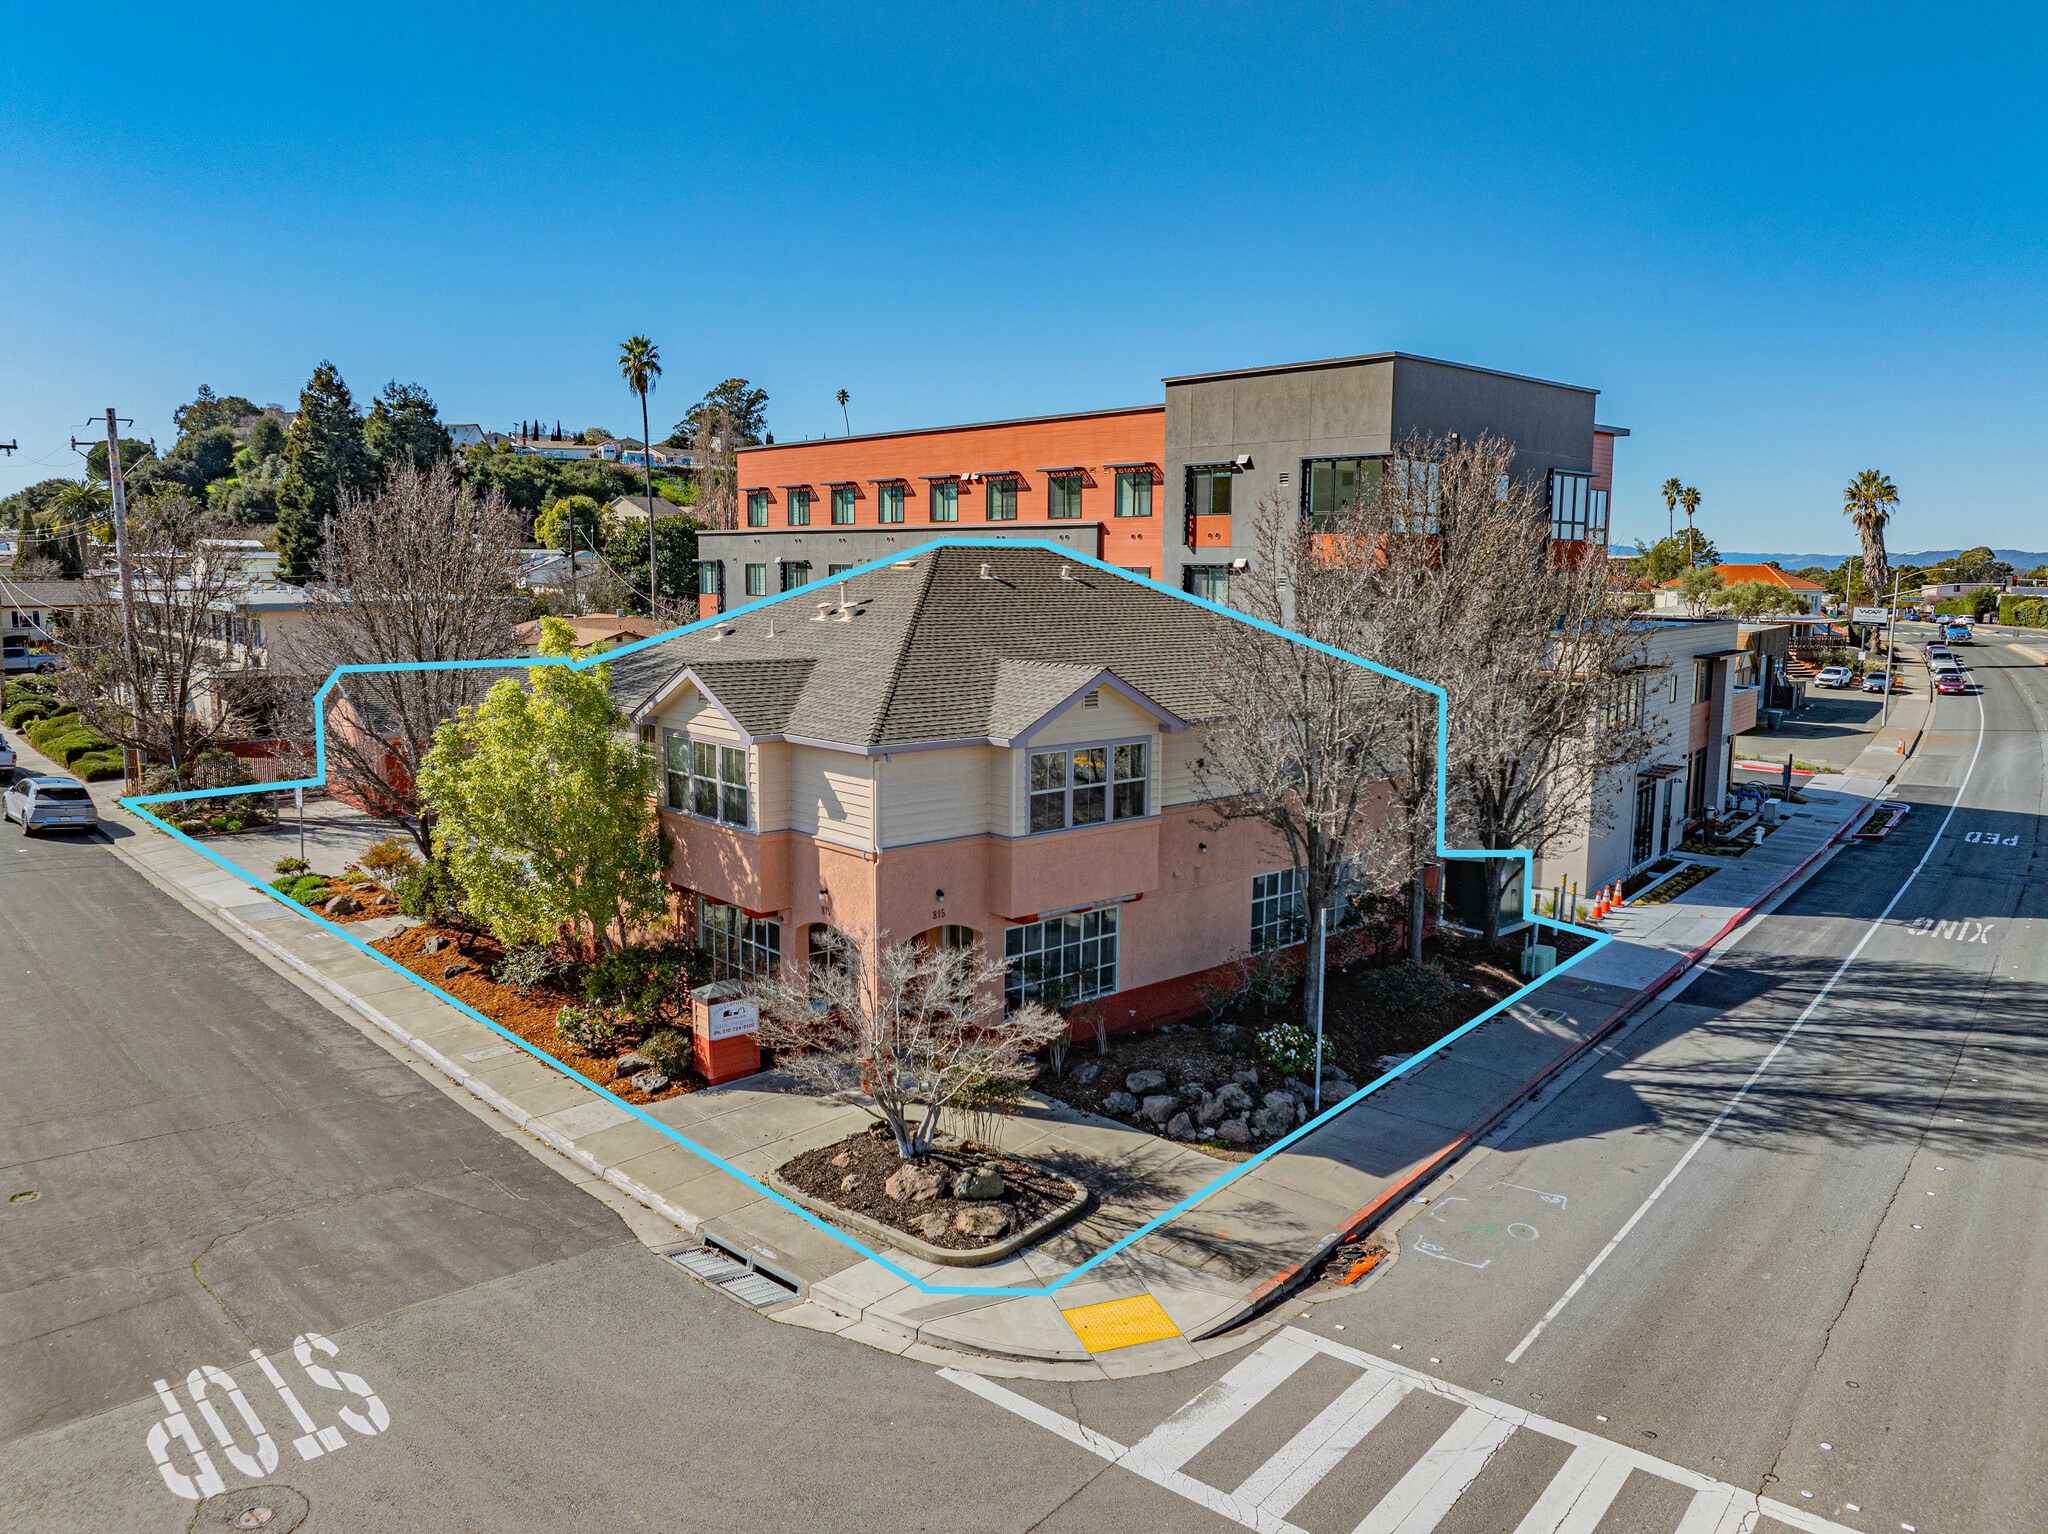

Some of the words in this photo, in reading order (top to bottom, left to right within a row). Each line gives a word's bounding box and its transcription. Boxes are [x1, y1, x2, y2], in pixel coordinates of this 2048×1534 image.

[1964, 831, 2020, 847] PED
[932, 908, 946, 920] 815
[1907, 916, 1995, 944] XING
[146, 1332, 391, 1501] STOP
